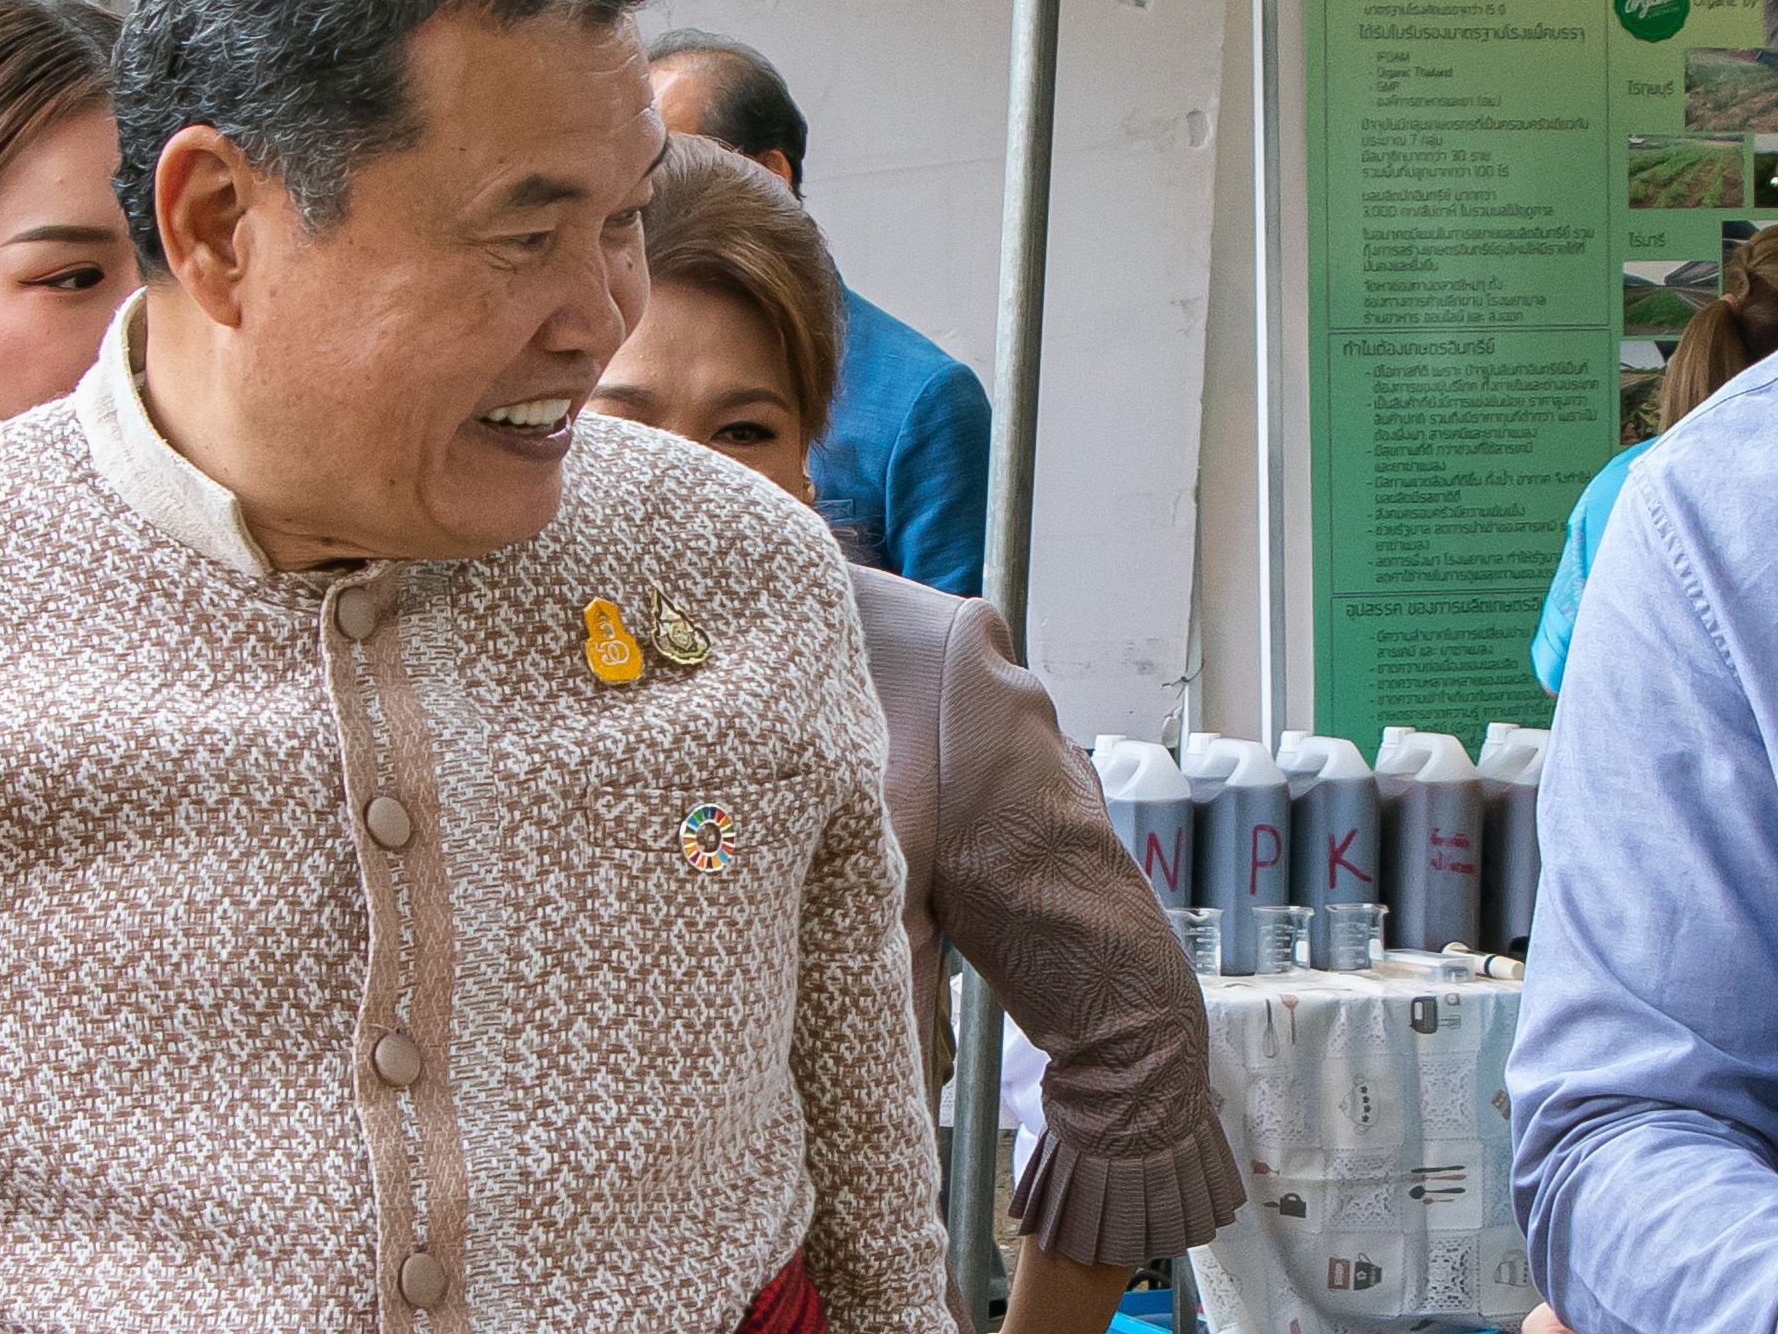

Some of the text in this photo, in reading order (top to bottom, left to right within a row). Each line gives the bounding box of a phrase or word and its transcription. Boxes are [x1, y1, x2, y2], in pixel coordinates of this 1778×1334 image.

[1144, 827, 1183, 893] N
[1249, 825, 1282, 896] P
[1328, 828, 1373, 890] K
